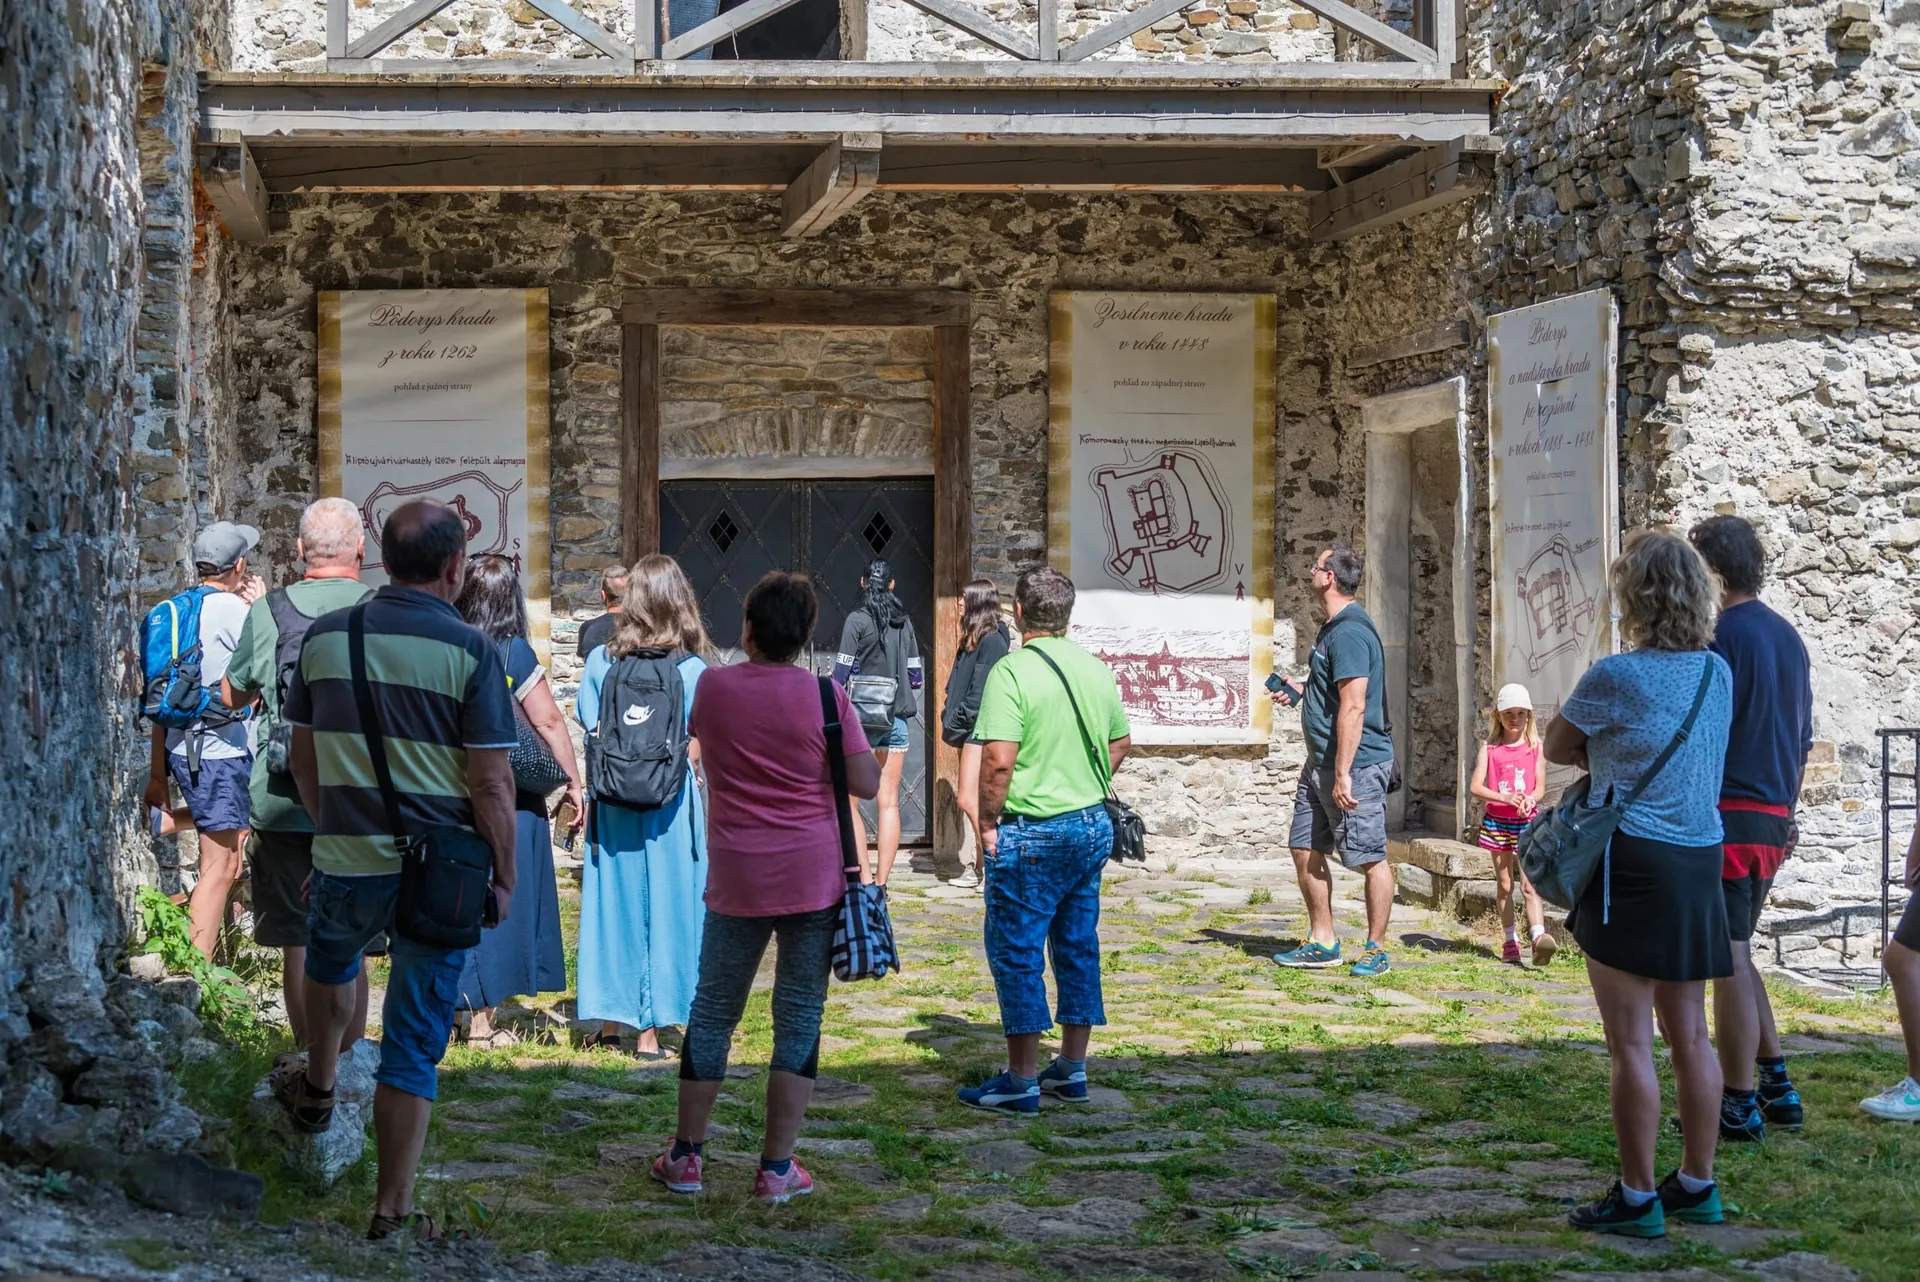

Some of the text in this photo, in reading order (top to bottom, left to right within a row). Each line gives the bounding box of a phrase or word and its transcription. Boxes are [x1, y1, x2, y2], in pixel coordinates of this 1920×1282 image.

[368, 304, 498, 334] Pôdorys hradu
[1093, 297, 1235, 328] Zosilnenie hradu
[1119, 340, 1129, 350] v
[1133, 331, 1168, 350] roku
[377, 340, 478, 368] z roku 1262
[1563, 351, 1592, 377] hradu
[394, 382, 420, 393] pohľad
[426, 382, 449, 392] južnej
[450, 383, 472, 392] strany
[1150, 378, 1183, 389] západnej
[1184, 380, 1206, 389] strany
[512, 537, 521, 550] S
[1235, 563, 1244, 576] V
[842, 655, 853, 665] UP
